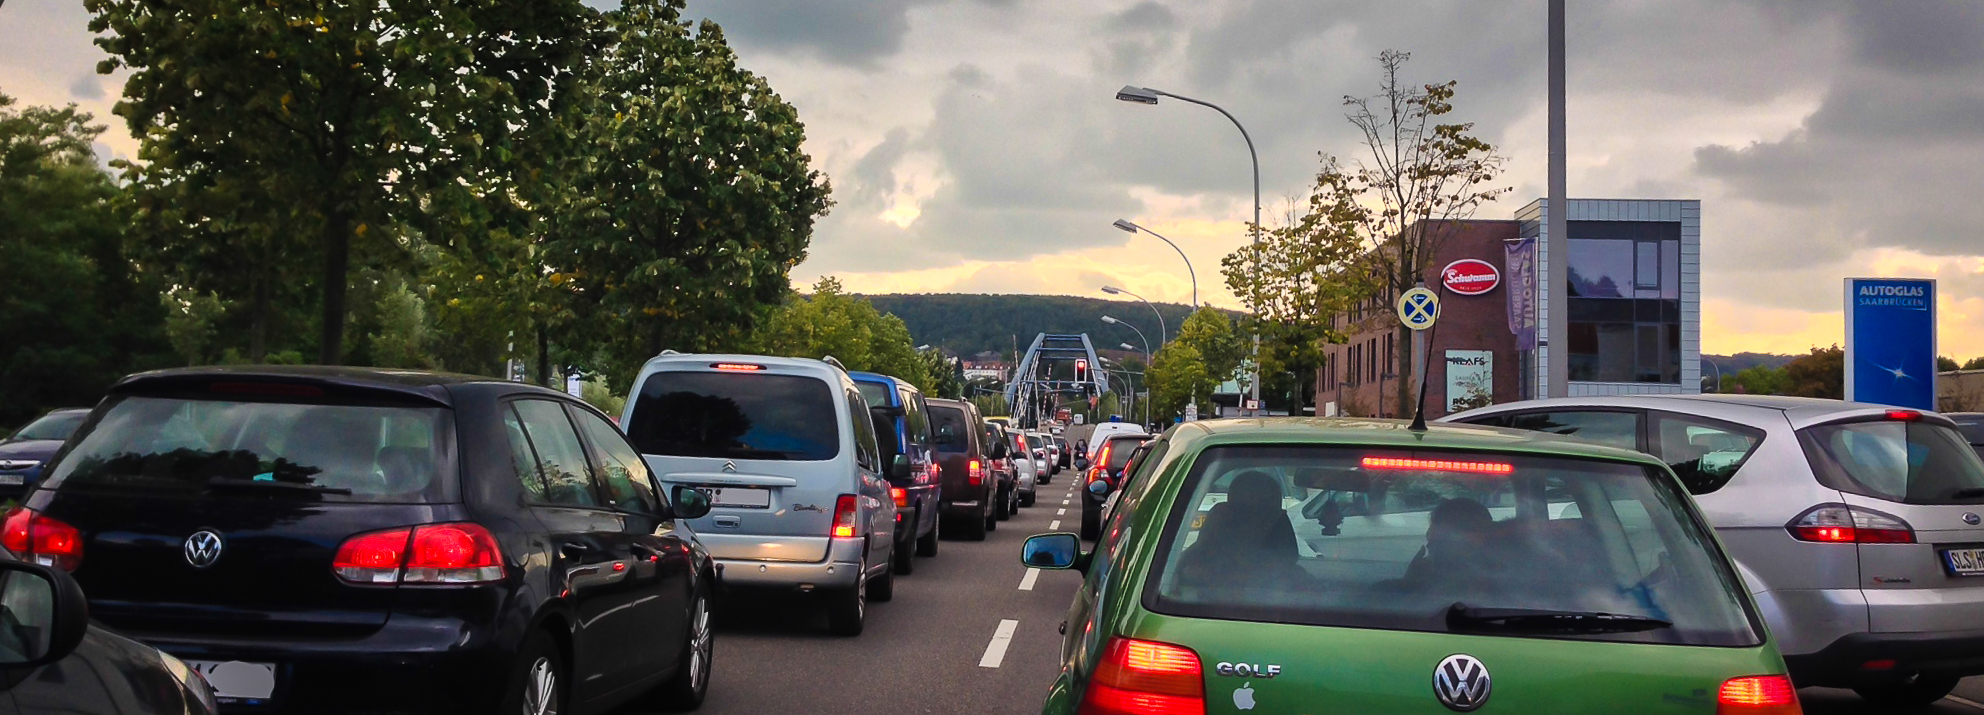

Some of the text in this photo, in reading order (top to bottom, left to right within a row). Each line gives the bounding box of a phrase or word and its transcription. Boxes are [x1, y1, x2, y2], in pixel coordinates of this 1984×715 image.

[1447, 271, 1496, 284] Schwamm
[1859, 285, 1924, 297] AUTOGLAS
[1859, 297, 1924, 307] SAARBRÜCKEN
[1951, 551, 1972, 569] SLS
[1216, 661, 1281, 678] GOLF
